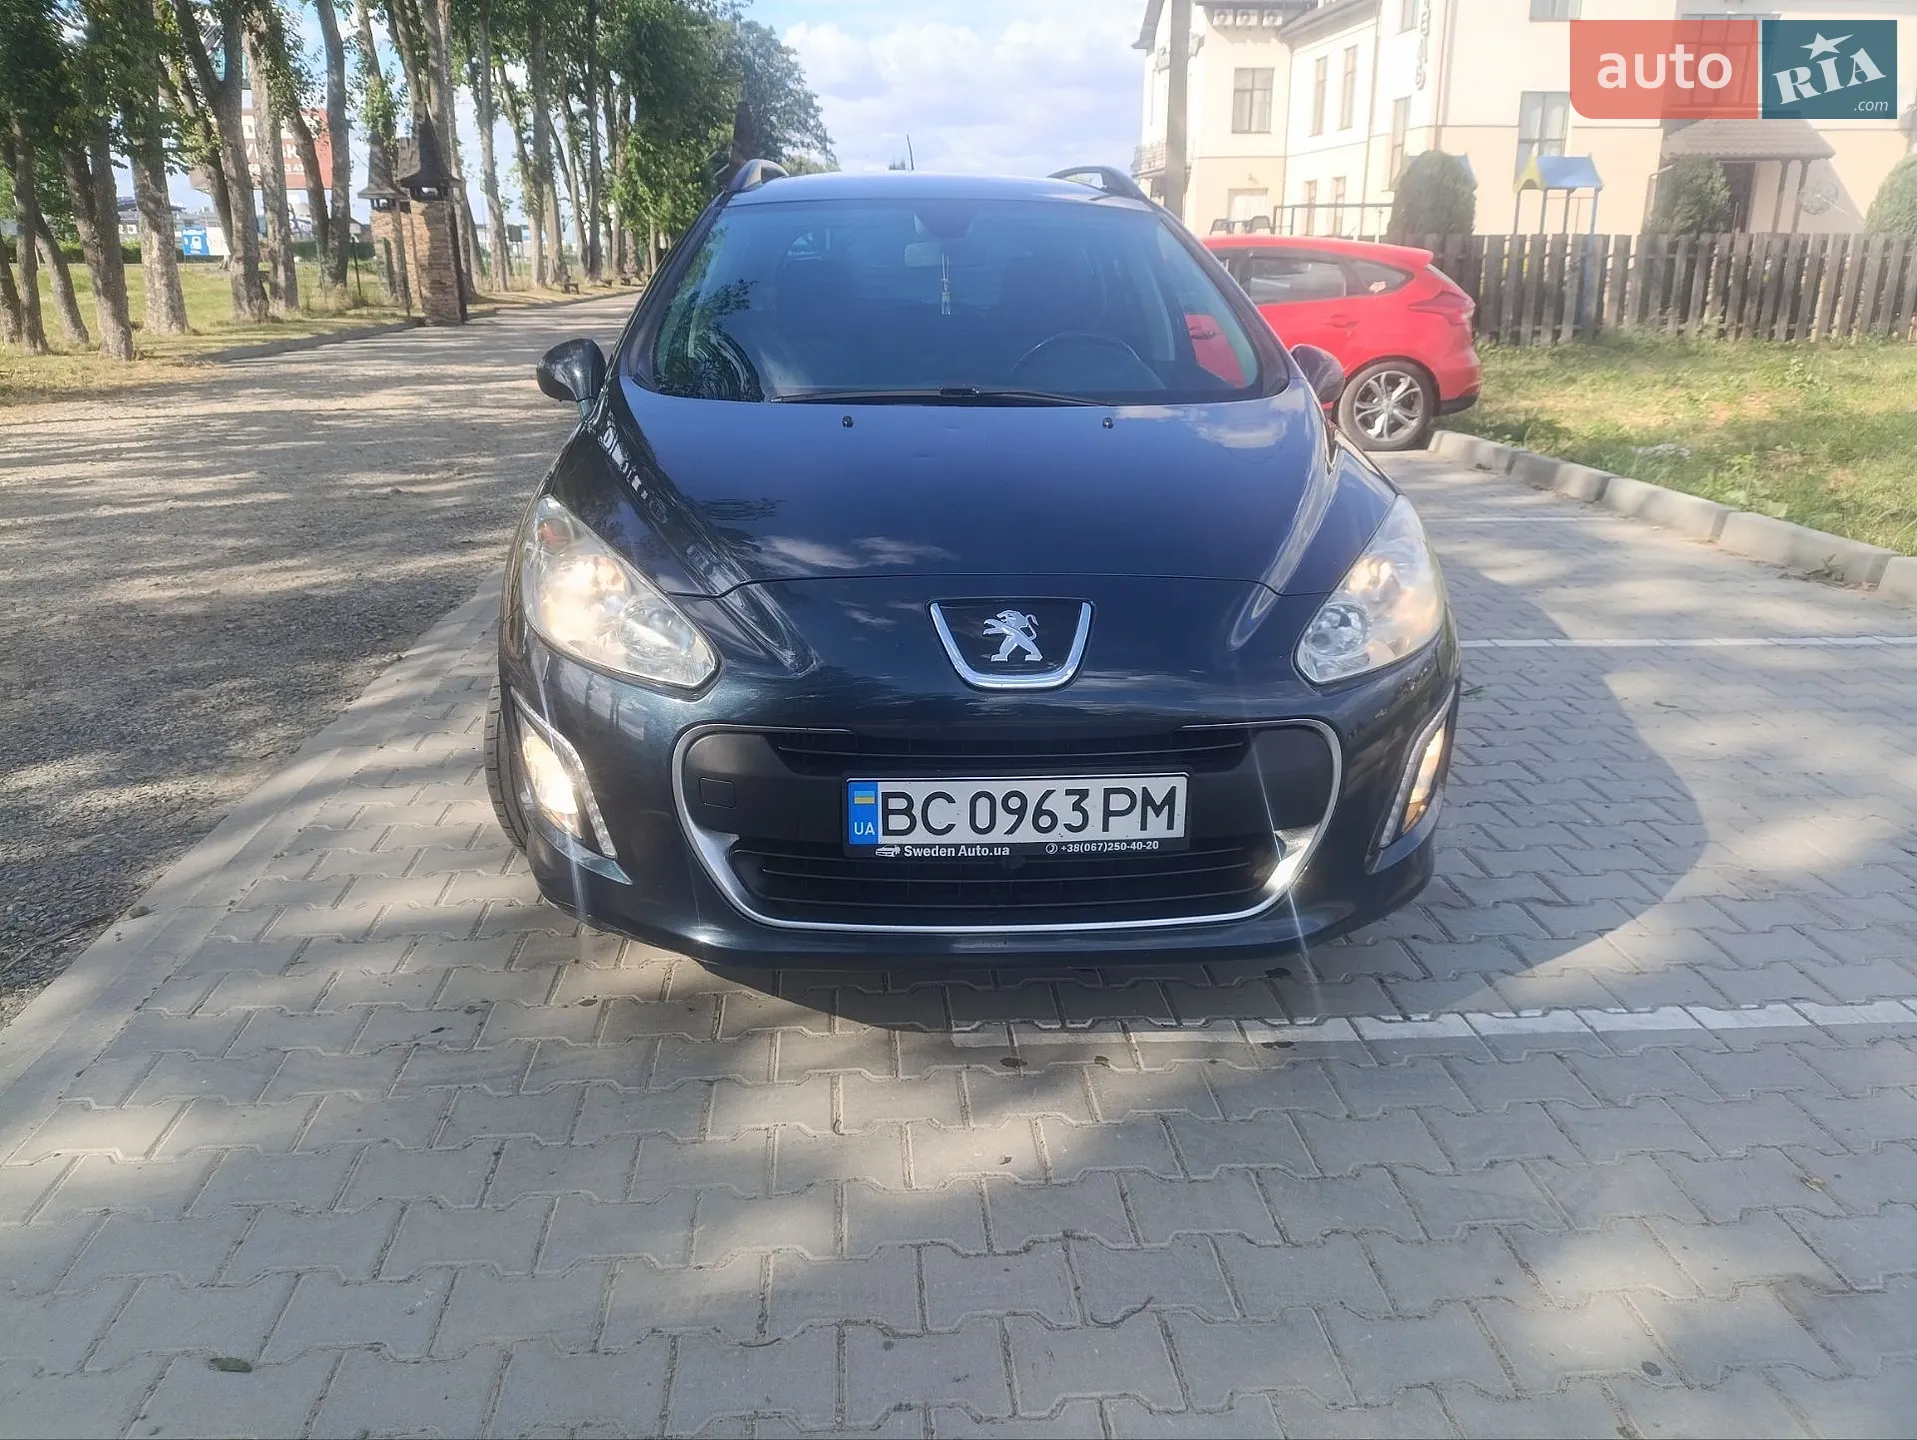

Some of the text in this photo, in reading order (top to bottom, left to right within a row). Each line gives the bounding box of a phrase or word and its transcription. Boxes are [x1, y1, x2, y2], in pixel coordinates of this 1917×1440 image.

[968, 788, 1090, 836] 0963
[853, 822, 876, 837] UA
[903, 845, 1010, 858] Sweden Auto.ua
[1060, 840, 1159, 854] +38(067)250-40-20
